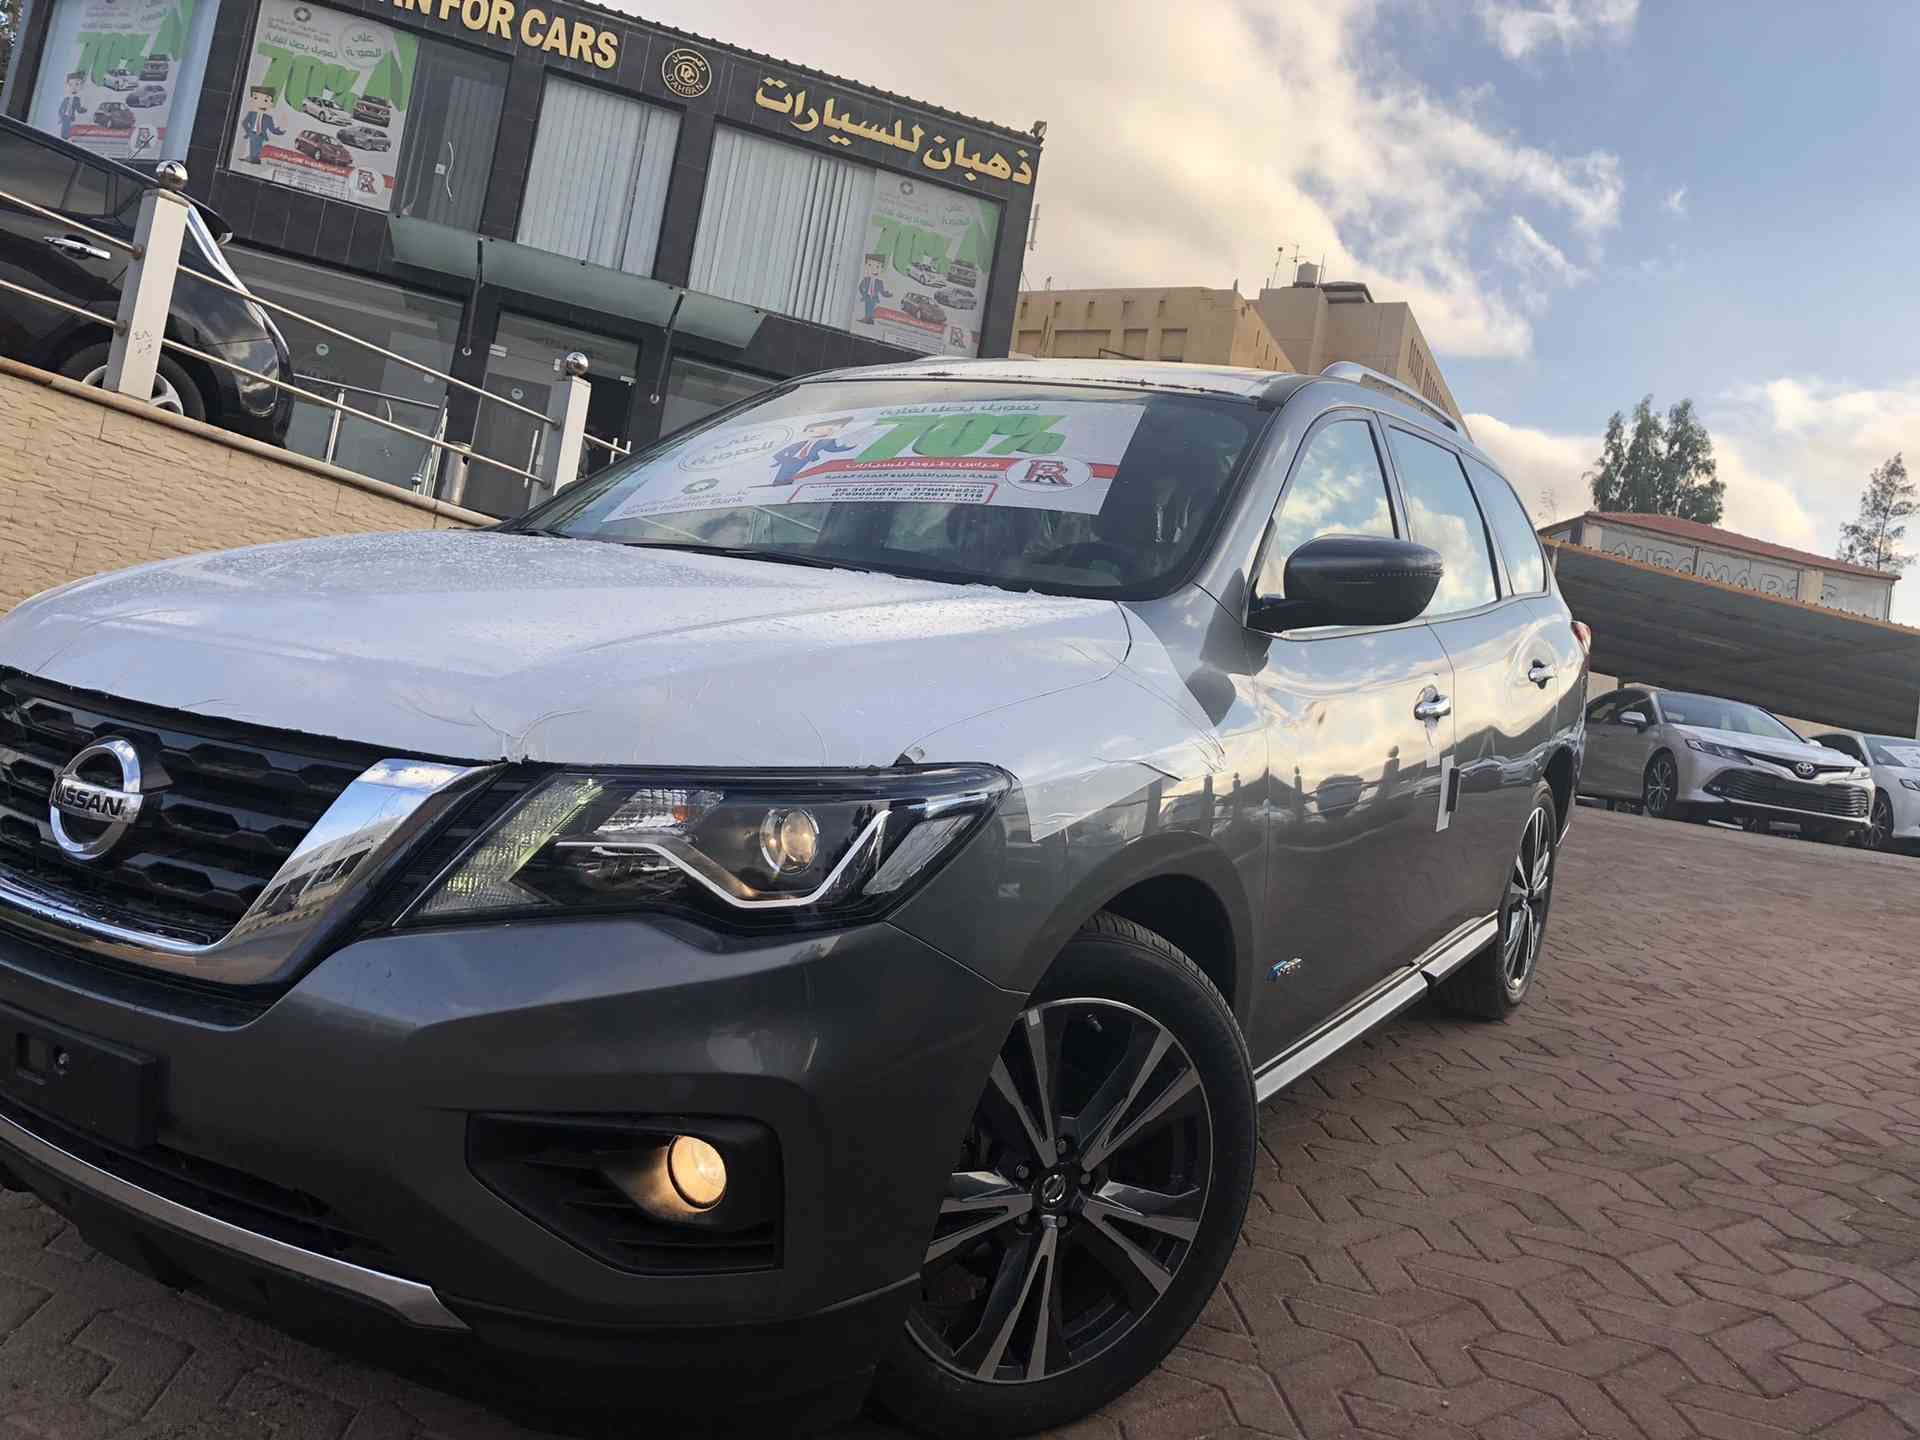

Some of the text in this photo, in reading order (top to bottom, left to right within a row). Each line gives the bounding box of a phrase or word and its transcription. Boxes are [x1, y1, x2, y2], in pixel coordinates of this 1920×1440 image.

[520, 9, 618, 69] CARS
[755, 77, 1032, 185] ذهبان للسيارات
[857, 413, 1068, 462] 70%
[49, 782, 123, 816] NISSAN
